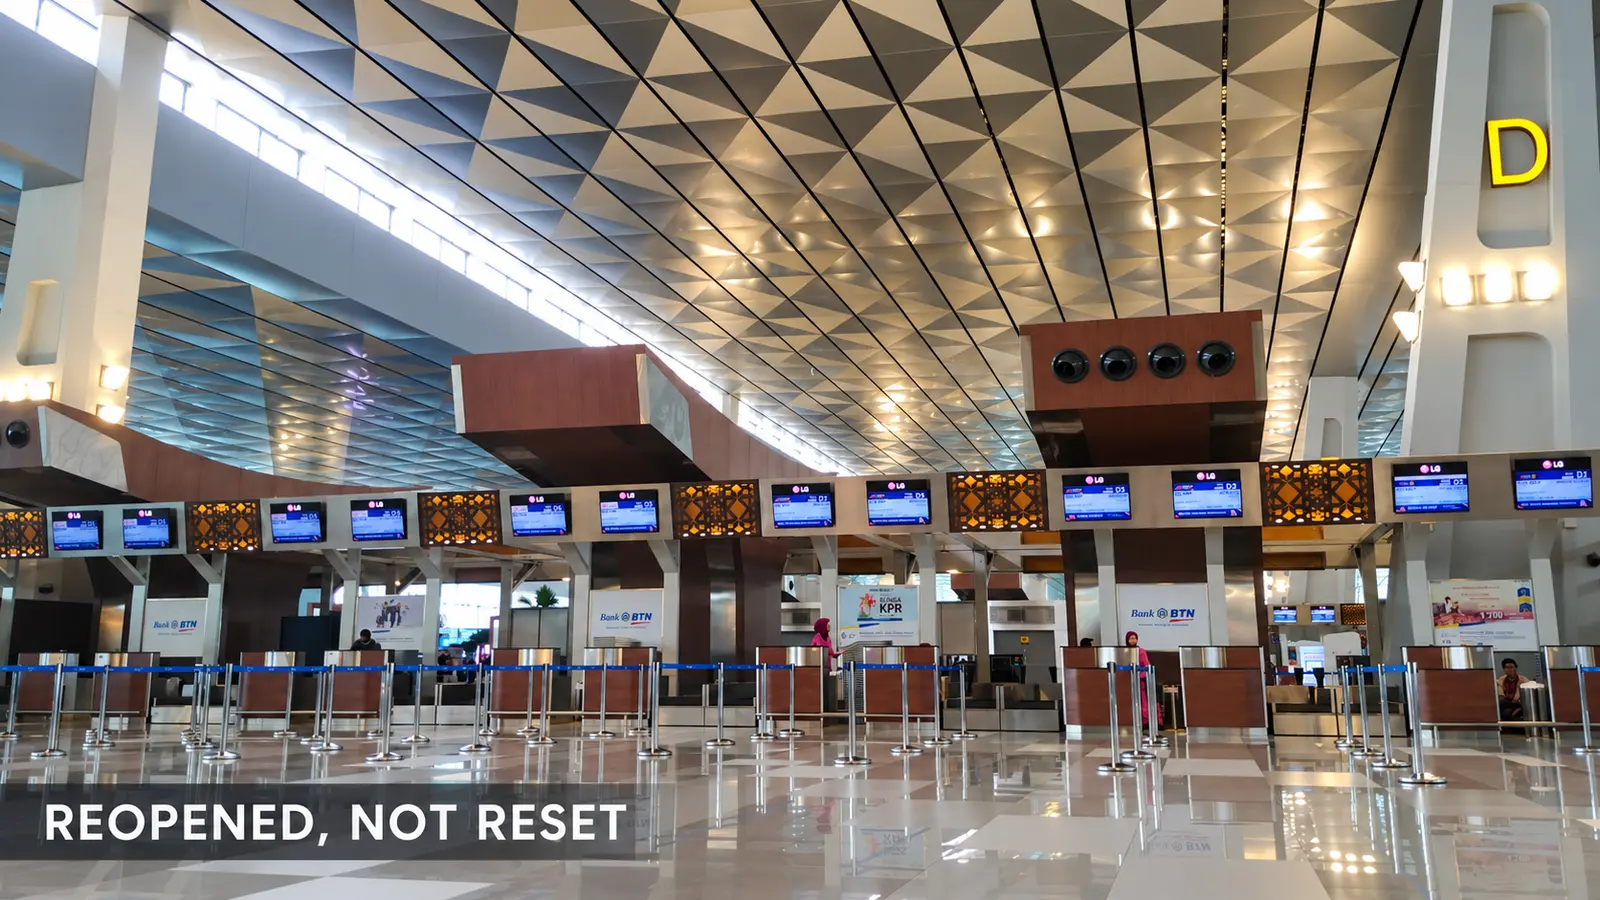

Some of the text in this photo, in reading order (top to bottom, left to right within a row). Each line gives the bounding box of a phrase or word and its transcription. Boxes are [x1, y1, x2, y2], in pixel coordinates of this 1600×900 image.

[1486, 117, 1549, 188] D
[879, 603, 902, 613] KPR
[600, 613, 652, 621] Bank BTN
[1131, 609, 1195, 617] Bank BTN
